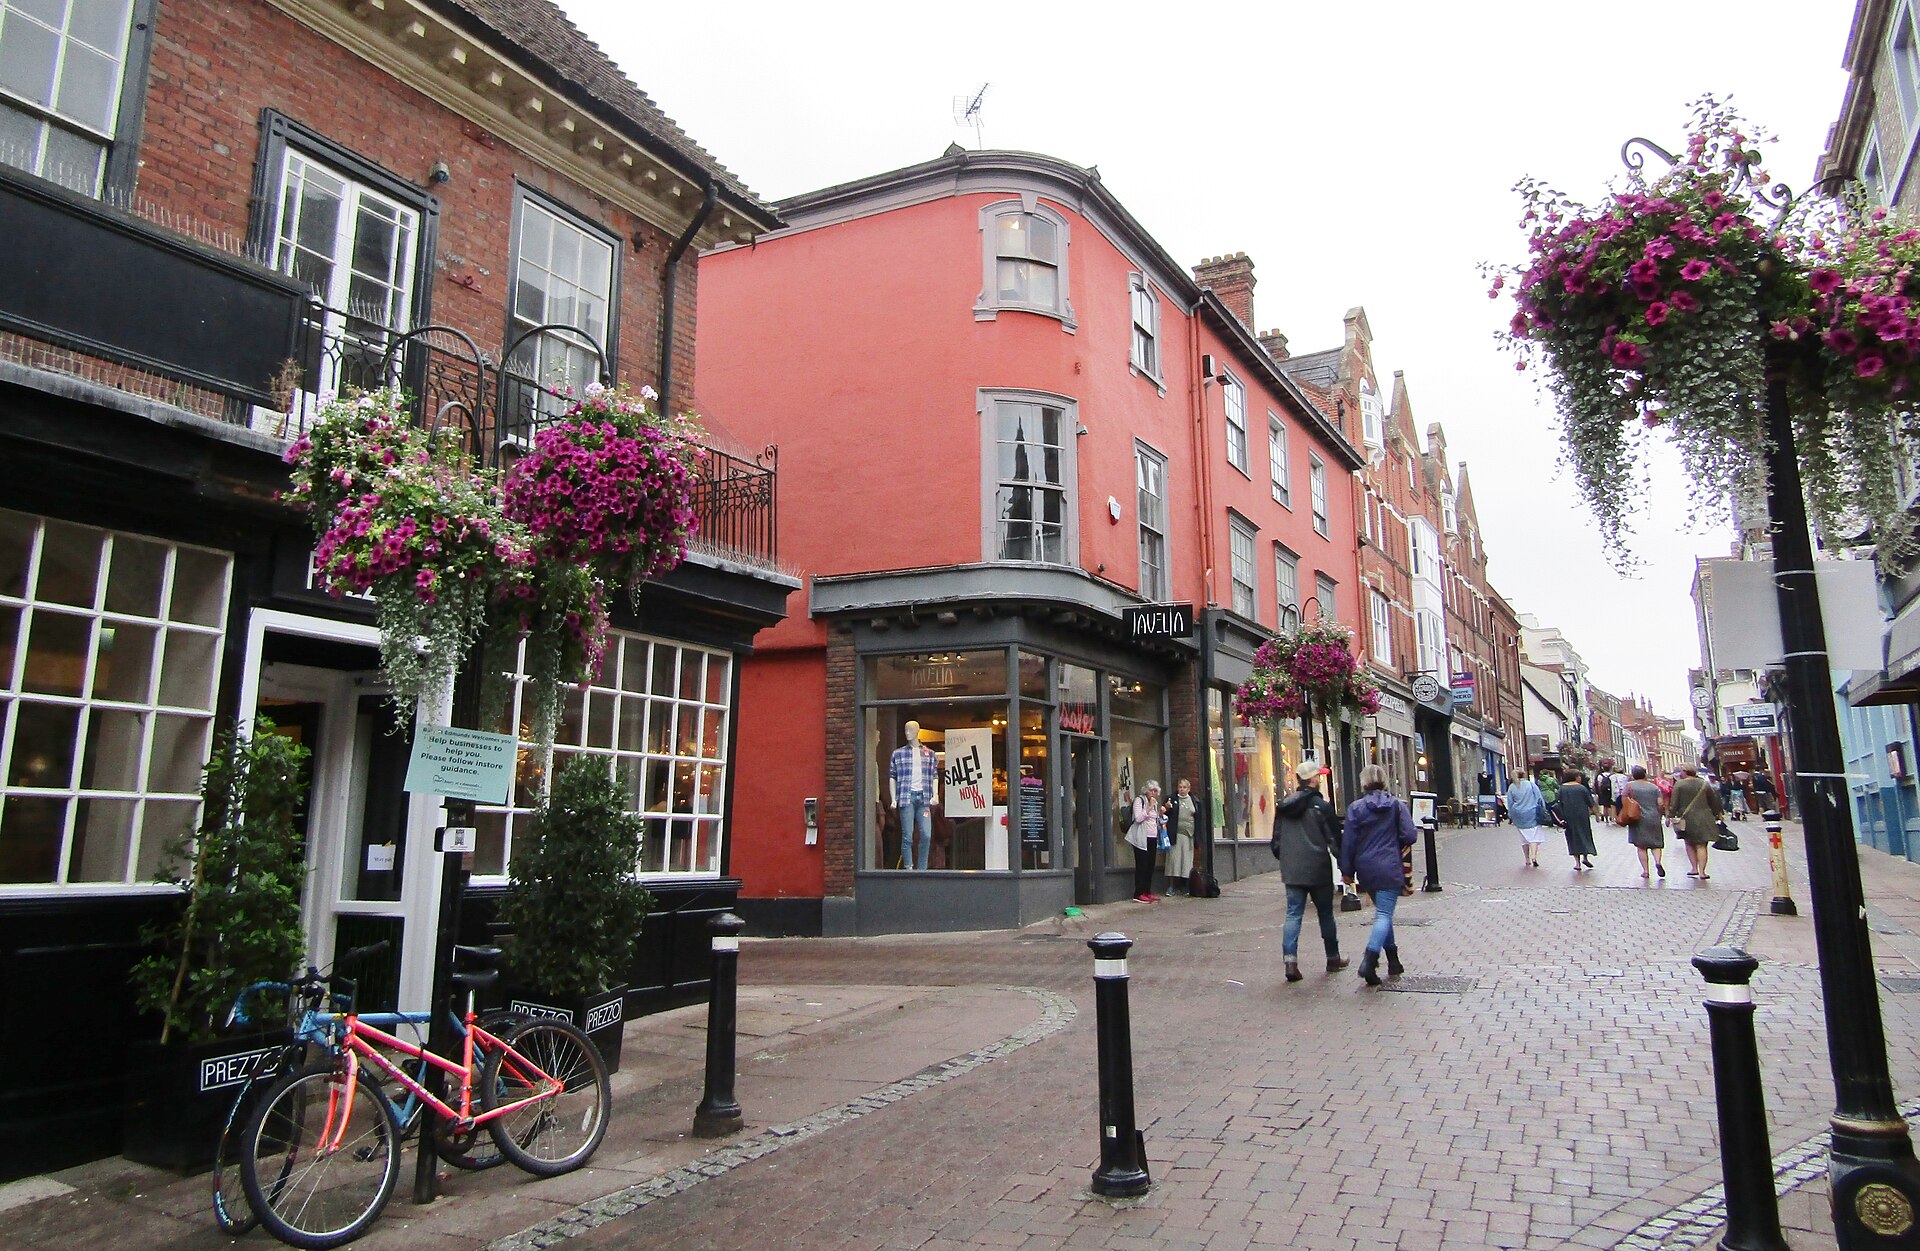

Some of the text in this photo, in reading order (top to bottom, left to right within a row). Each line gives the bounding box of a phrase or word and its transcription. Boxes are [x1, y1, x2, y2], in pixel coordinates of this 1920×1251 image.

[1132, 607, 1184, 636] JAVELIN
[428, 735, 447, 745] Help
[449, 739, 492, 751] businesses
[472, 734, 500, 742] Welcomes
[445, 747, 463, 756] help
[420, 752, 503, 770] Please follow instore
[945, 745, 983, 786] SALE!
[440, 765, 480, 775] guidance.
[959, 784, 979, 801] NOW
[972, 794, 986, 809] ON
[588, 1003, 621, 1031] PREZZO
